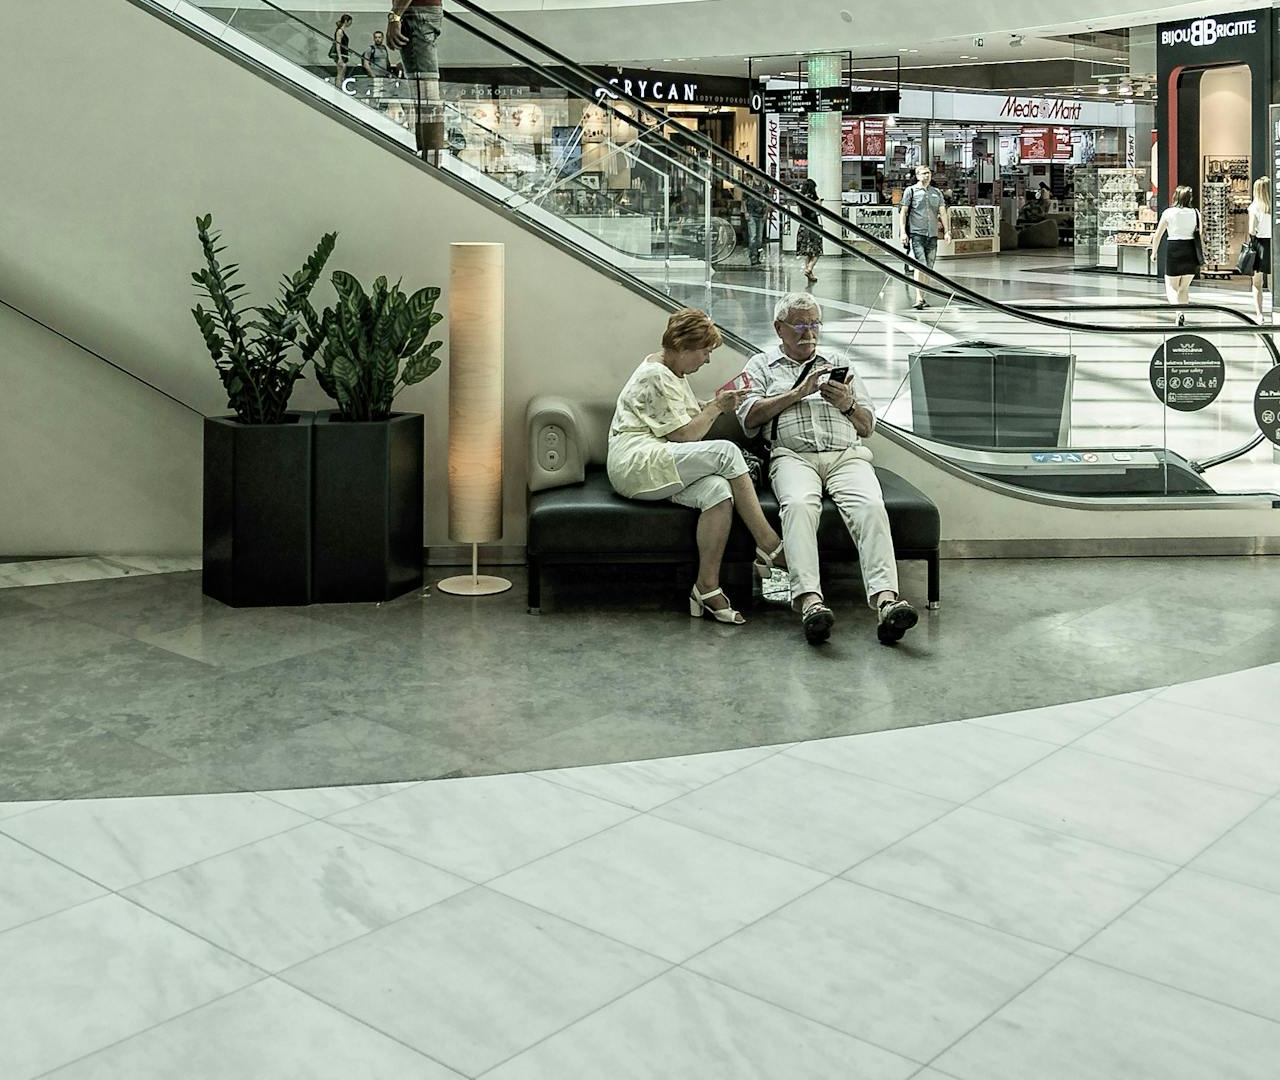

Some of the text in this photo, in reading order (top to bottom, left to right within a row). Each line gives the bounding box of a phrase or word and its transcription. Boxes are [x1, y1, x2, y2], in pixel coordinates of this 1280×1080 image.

[752, 94, 762, 110] 0
[999, 96, 1082, 120] Media Markt
